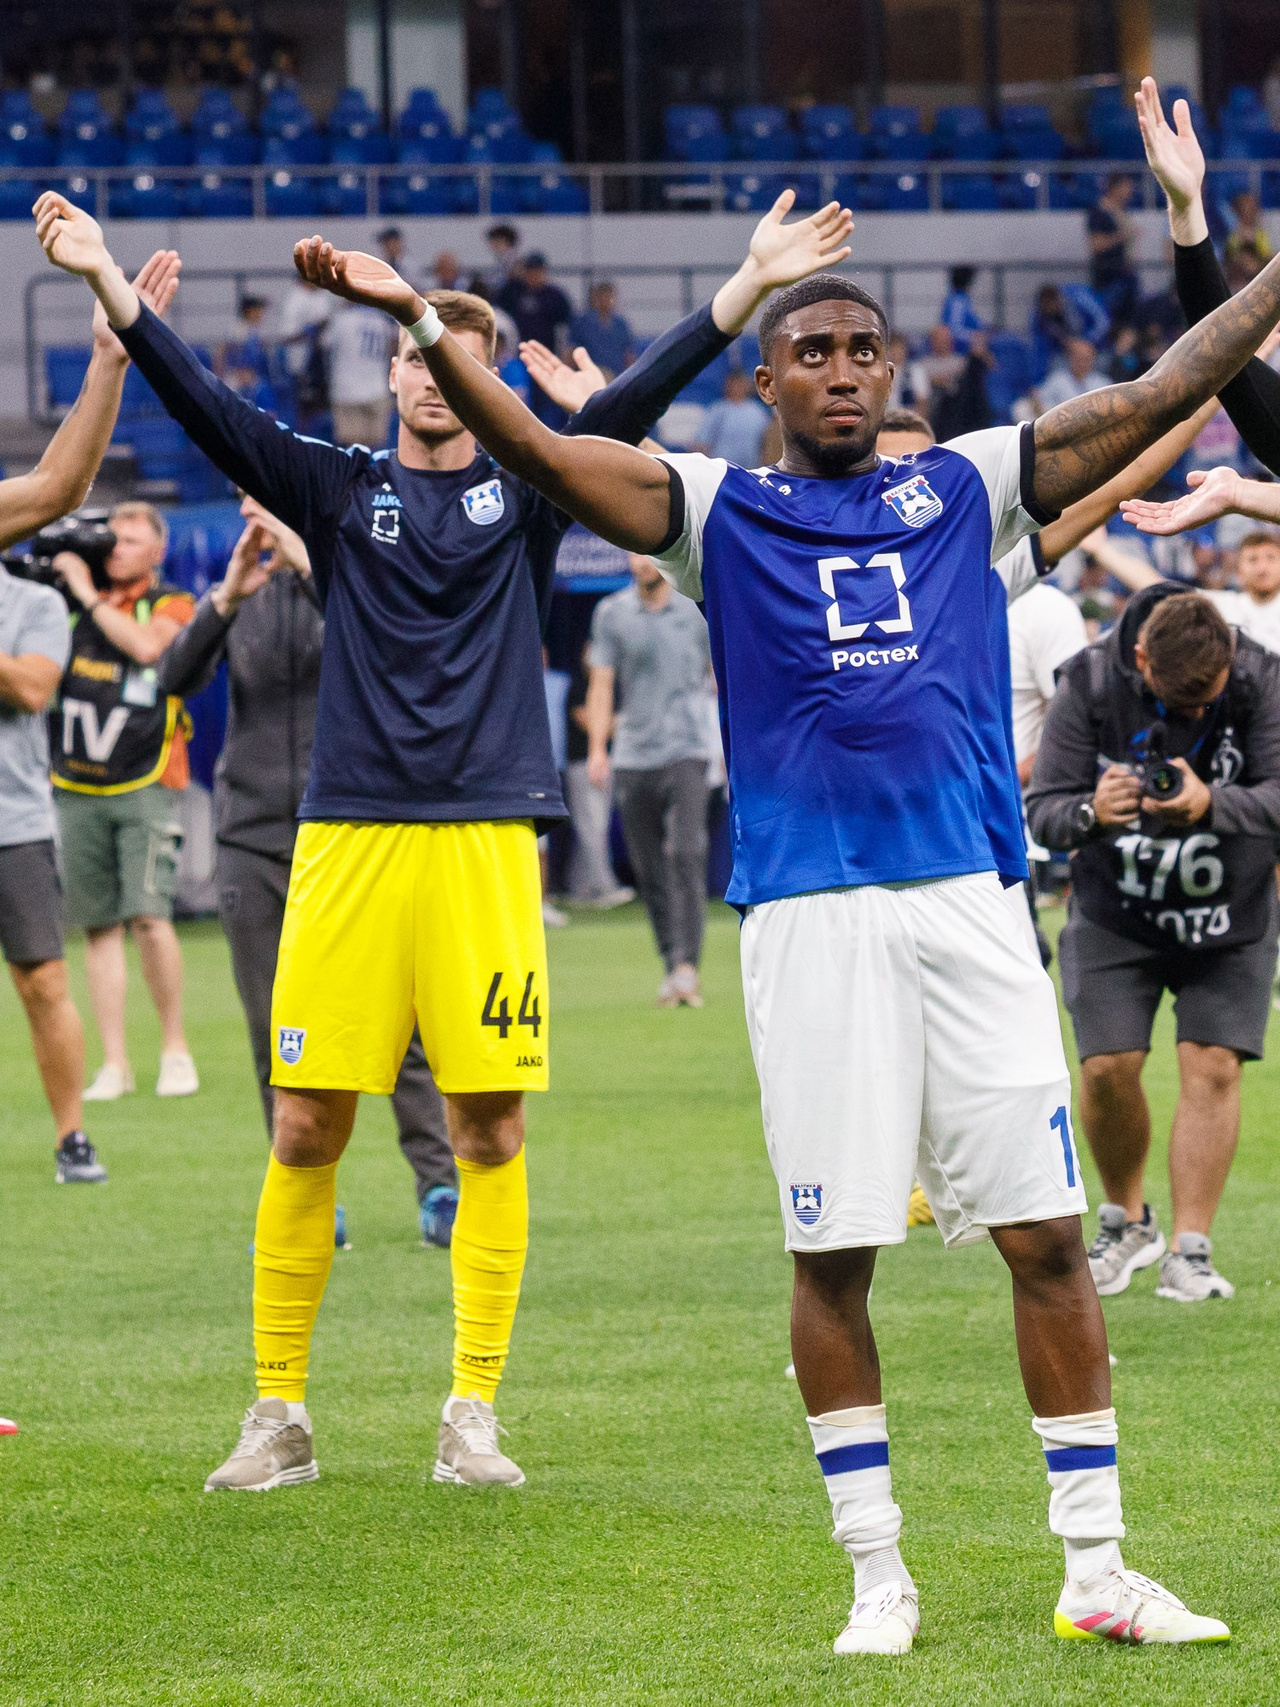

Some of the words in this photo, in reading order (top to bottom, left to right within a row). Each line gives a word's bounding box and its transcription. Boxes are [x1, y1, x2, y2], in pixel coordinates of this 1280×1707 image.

[831, 645, 919, 671] Ростех
[1114, 833, 1224, 900] 176
[481, 971, 541, 1038] 44
[515, 1055, 543, 1067] JAKO
[1049, 1105, 1081, 1188] 1
[257, 1361, 288, 1371] AKO
